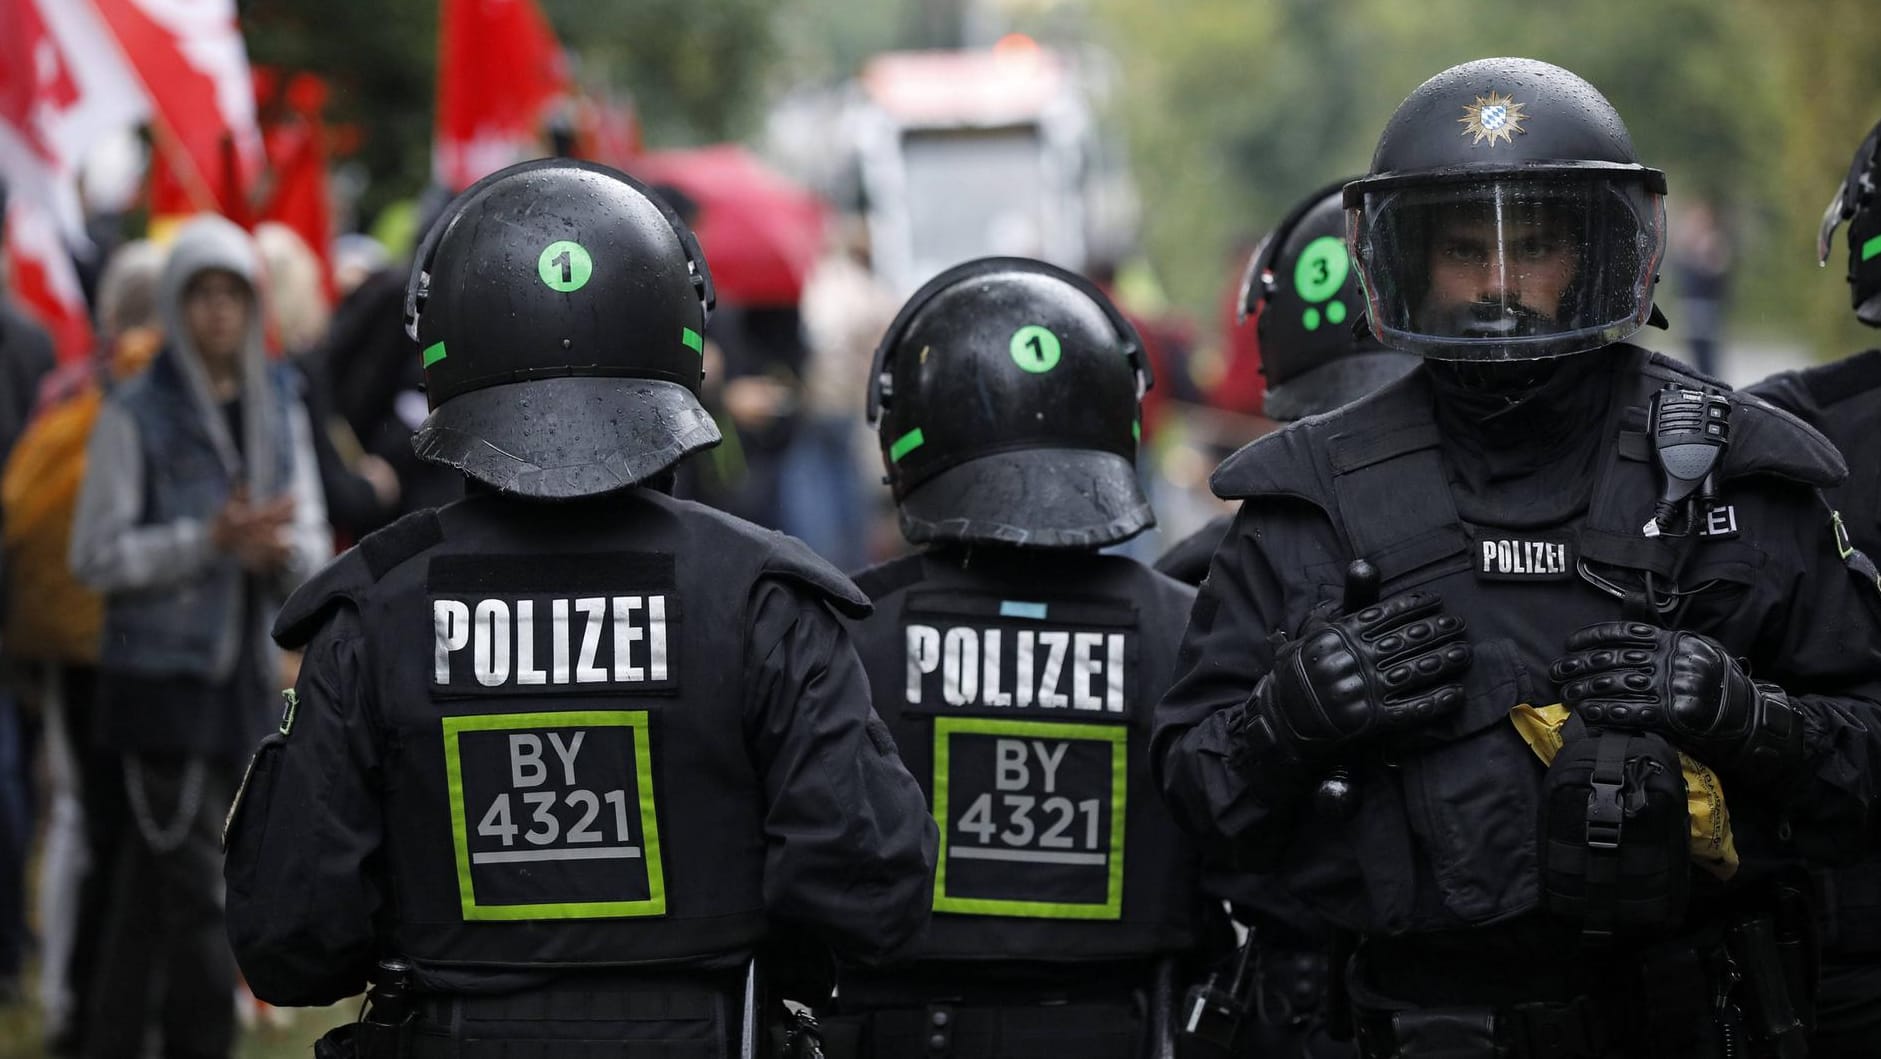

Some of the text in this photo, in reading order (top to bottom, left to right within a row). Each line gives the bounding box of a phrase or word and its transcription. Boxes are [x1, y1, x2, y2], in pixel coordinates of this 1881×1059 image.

[551, 251, 572, 283] 1
[1312, 258, 1329, 285] 3
[1025, 335, 1045, 362] 1
[1482, 540, 1566, 573] POLIZEI
[433, 595, 668, 687] POLIZEI
[905, 624, 1125, 712] POLIZEI
[508, 730, 586, 788] BY
[995, 738, 1069, 792] BY
[477, 789, 629, 846] 4321
[957, 793, 1100, 849] 4321
